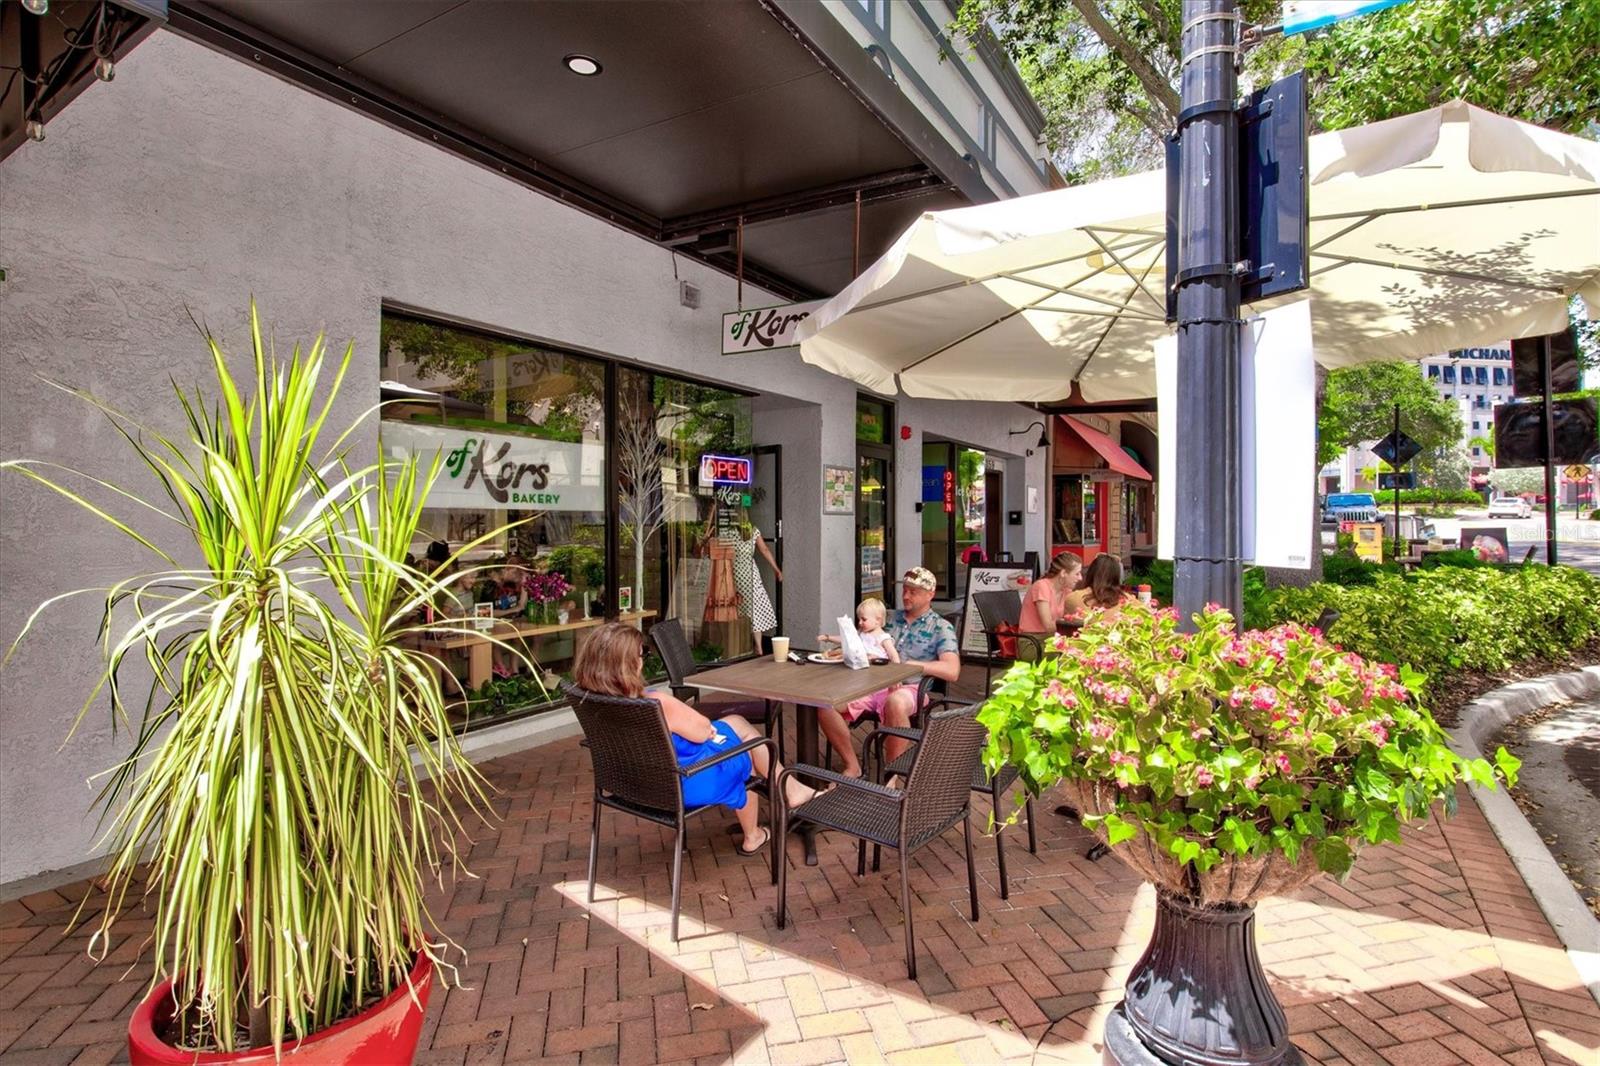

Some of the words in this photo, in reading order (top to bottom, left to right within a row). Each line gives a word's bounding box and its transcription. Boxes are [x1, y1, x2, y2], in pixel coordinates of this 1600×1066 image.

[731, 312, 752, 341] of
[446, 438, 478, 478] of
[464, 440, 550, 503] Kors
[705, 459, 747, 479] OPEN
[512, 493, 560, 504] BAKERY
[977, 571, 1000, 585] Kors
